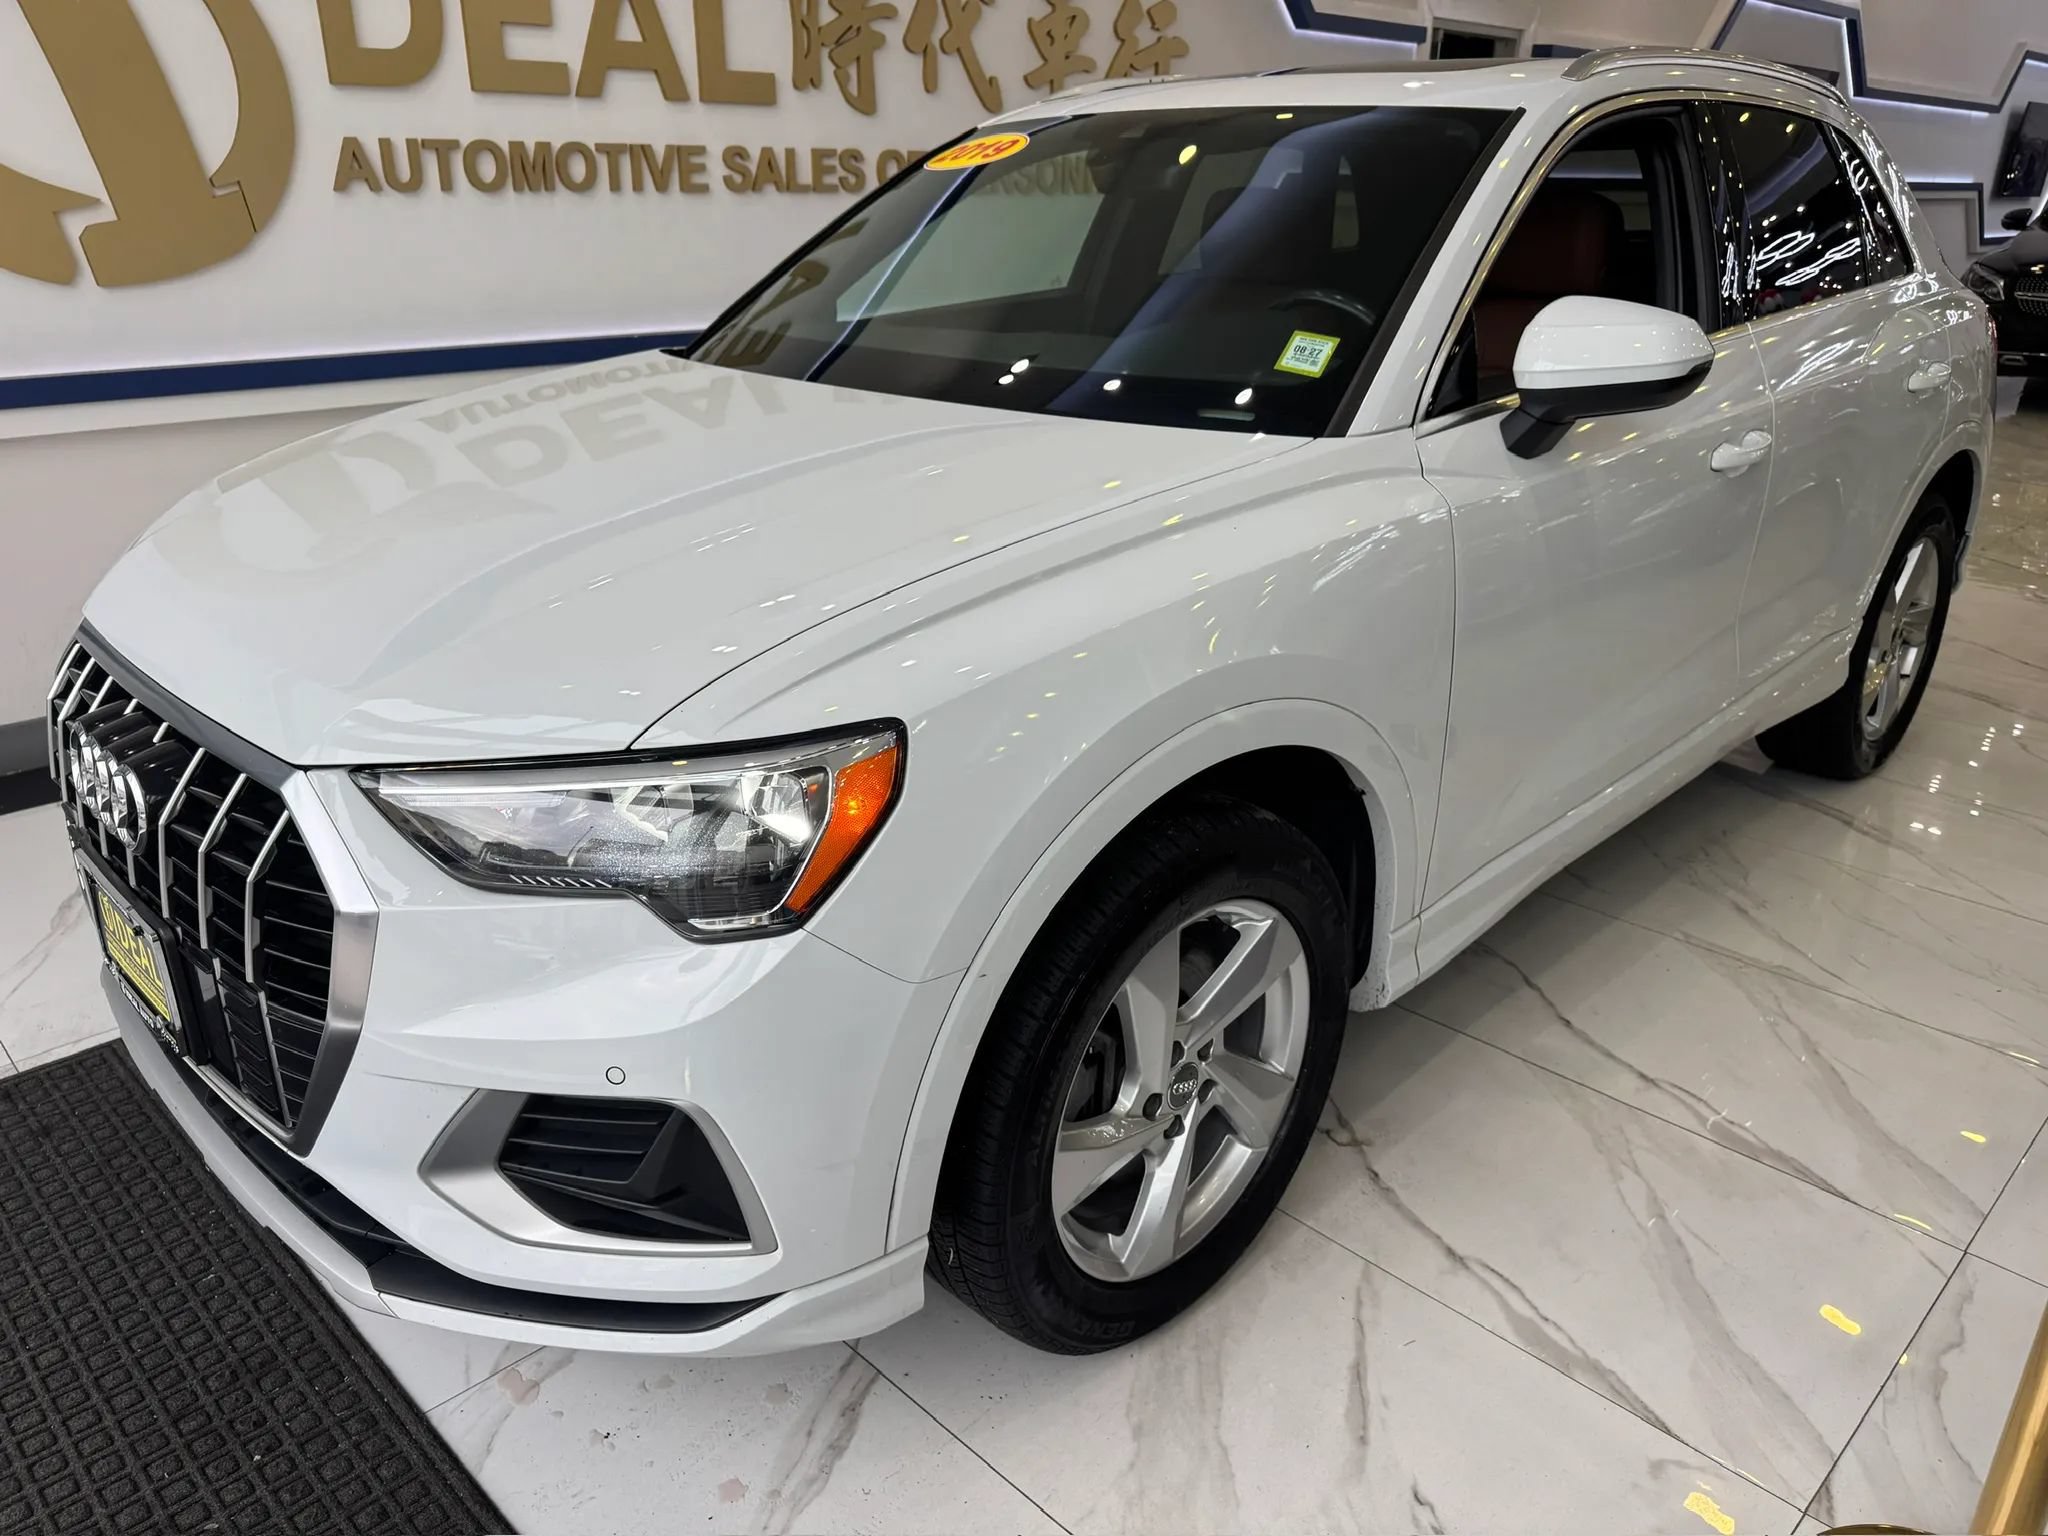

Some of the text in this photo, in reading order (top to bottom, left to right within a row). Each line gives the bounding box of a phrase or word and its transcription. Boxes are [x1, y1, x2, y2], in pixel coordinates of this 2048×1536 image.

[333, 136, 709, 193] AUTOMOTIVE
[721, 145, 866, 194] SALES
[934, 138, 1021, 164] 2019
